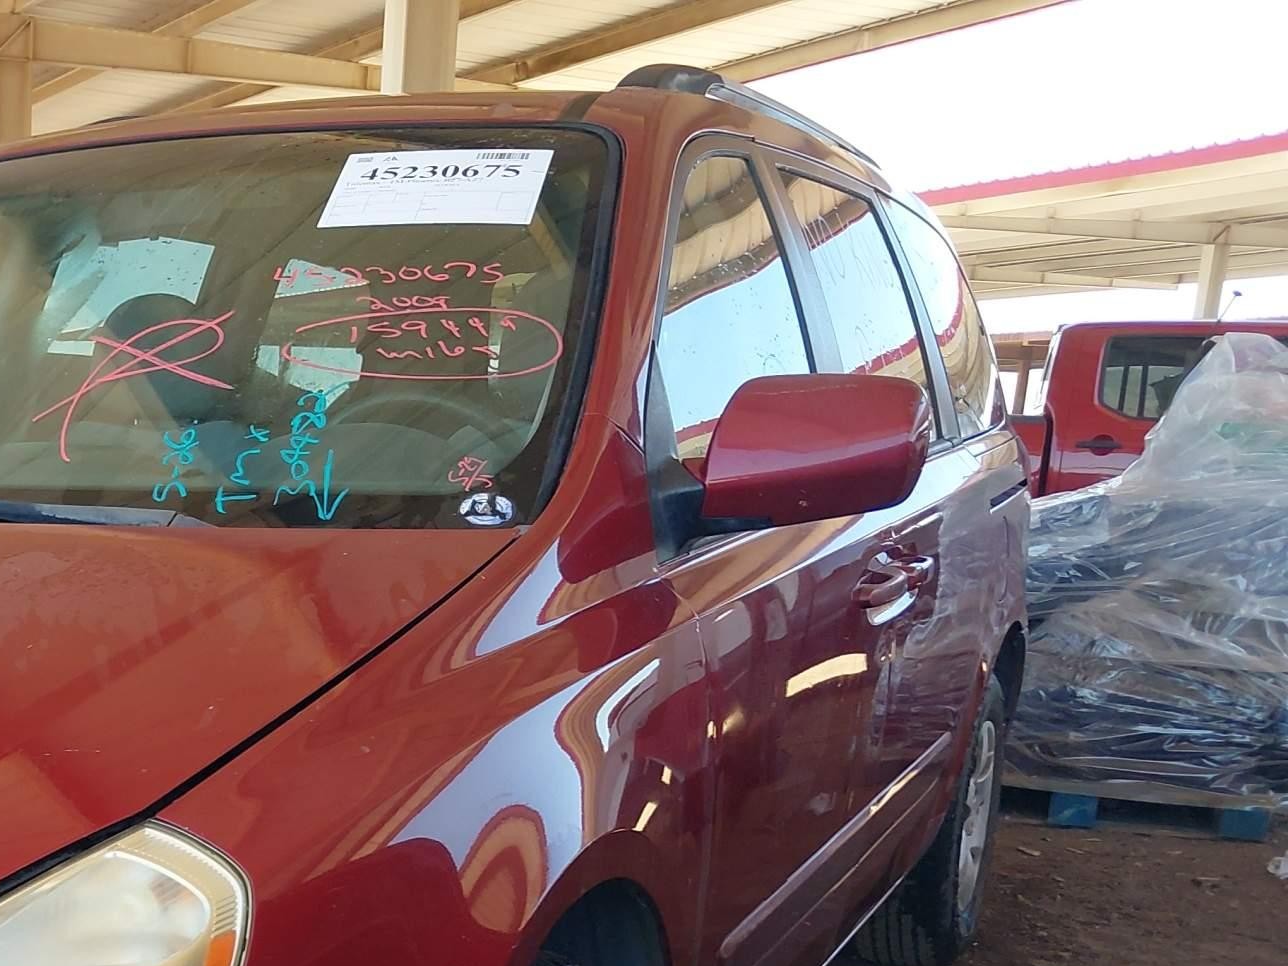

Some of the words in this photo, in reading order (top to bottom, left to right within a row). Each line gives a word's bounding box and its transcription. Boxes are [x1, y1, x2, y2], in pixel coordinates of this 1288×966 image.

[360, 164, 523, 182] 45230675
[273, 261, 505, 288] 45230675
[355, 295, 451, 311] 2009
